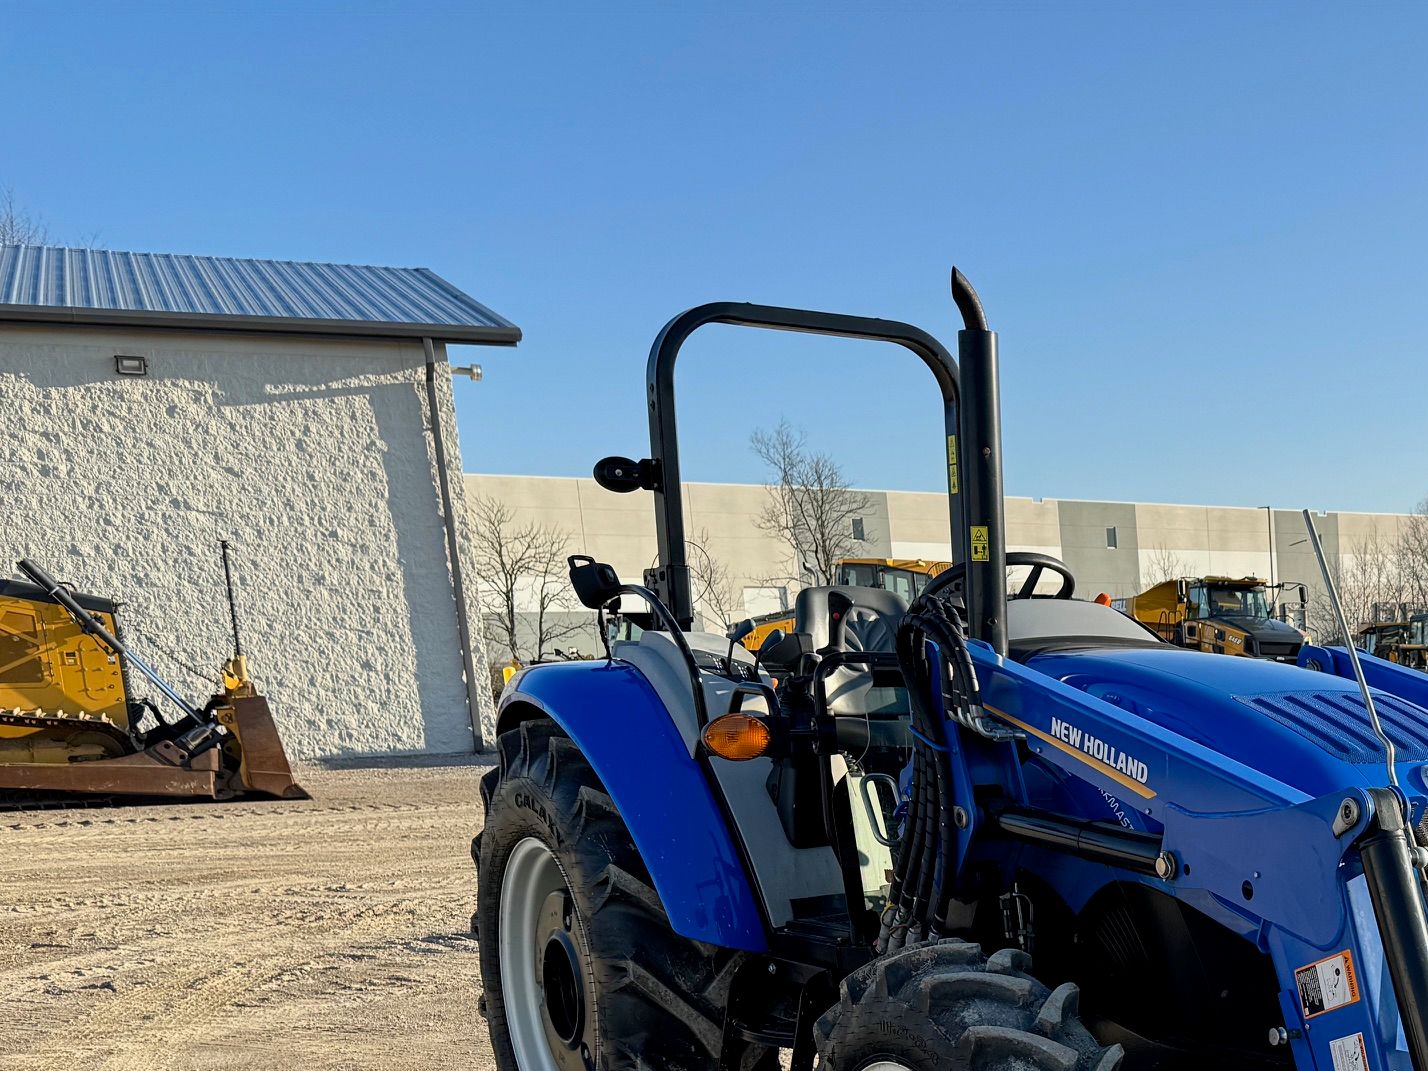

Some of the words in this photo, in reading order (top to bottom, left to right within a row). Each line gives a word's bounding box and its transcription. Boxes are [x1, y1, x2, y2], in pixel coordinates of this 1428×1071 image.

[1051, 717, 1081, 748] NEW
[1083, 733, 1148, 784] HOLLAND
[1346, 965, 1357, 998] WARNING
